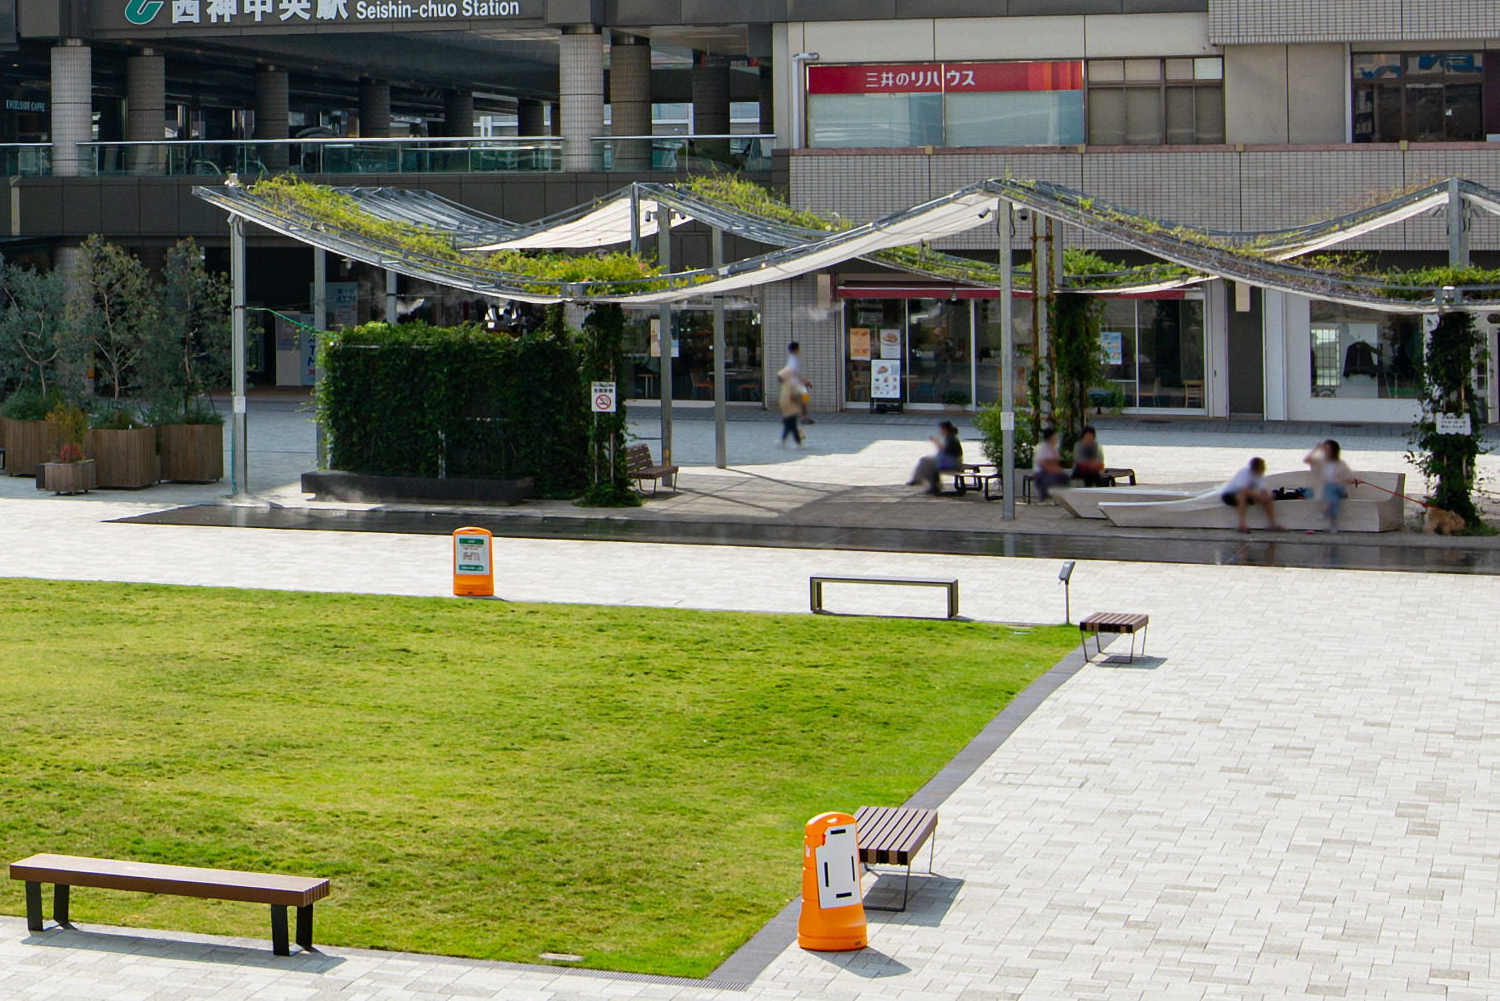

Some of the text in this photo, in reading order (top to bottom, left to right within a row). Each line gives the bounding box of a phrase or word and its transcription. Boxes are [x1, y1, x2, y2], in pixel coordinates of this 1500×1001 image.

[356, 0, 458, 20] Seishin-chuo
[865, 69, 976, 88] 三井のリハウス
